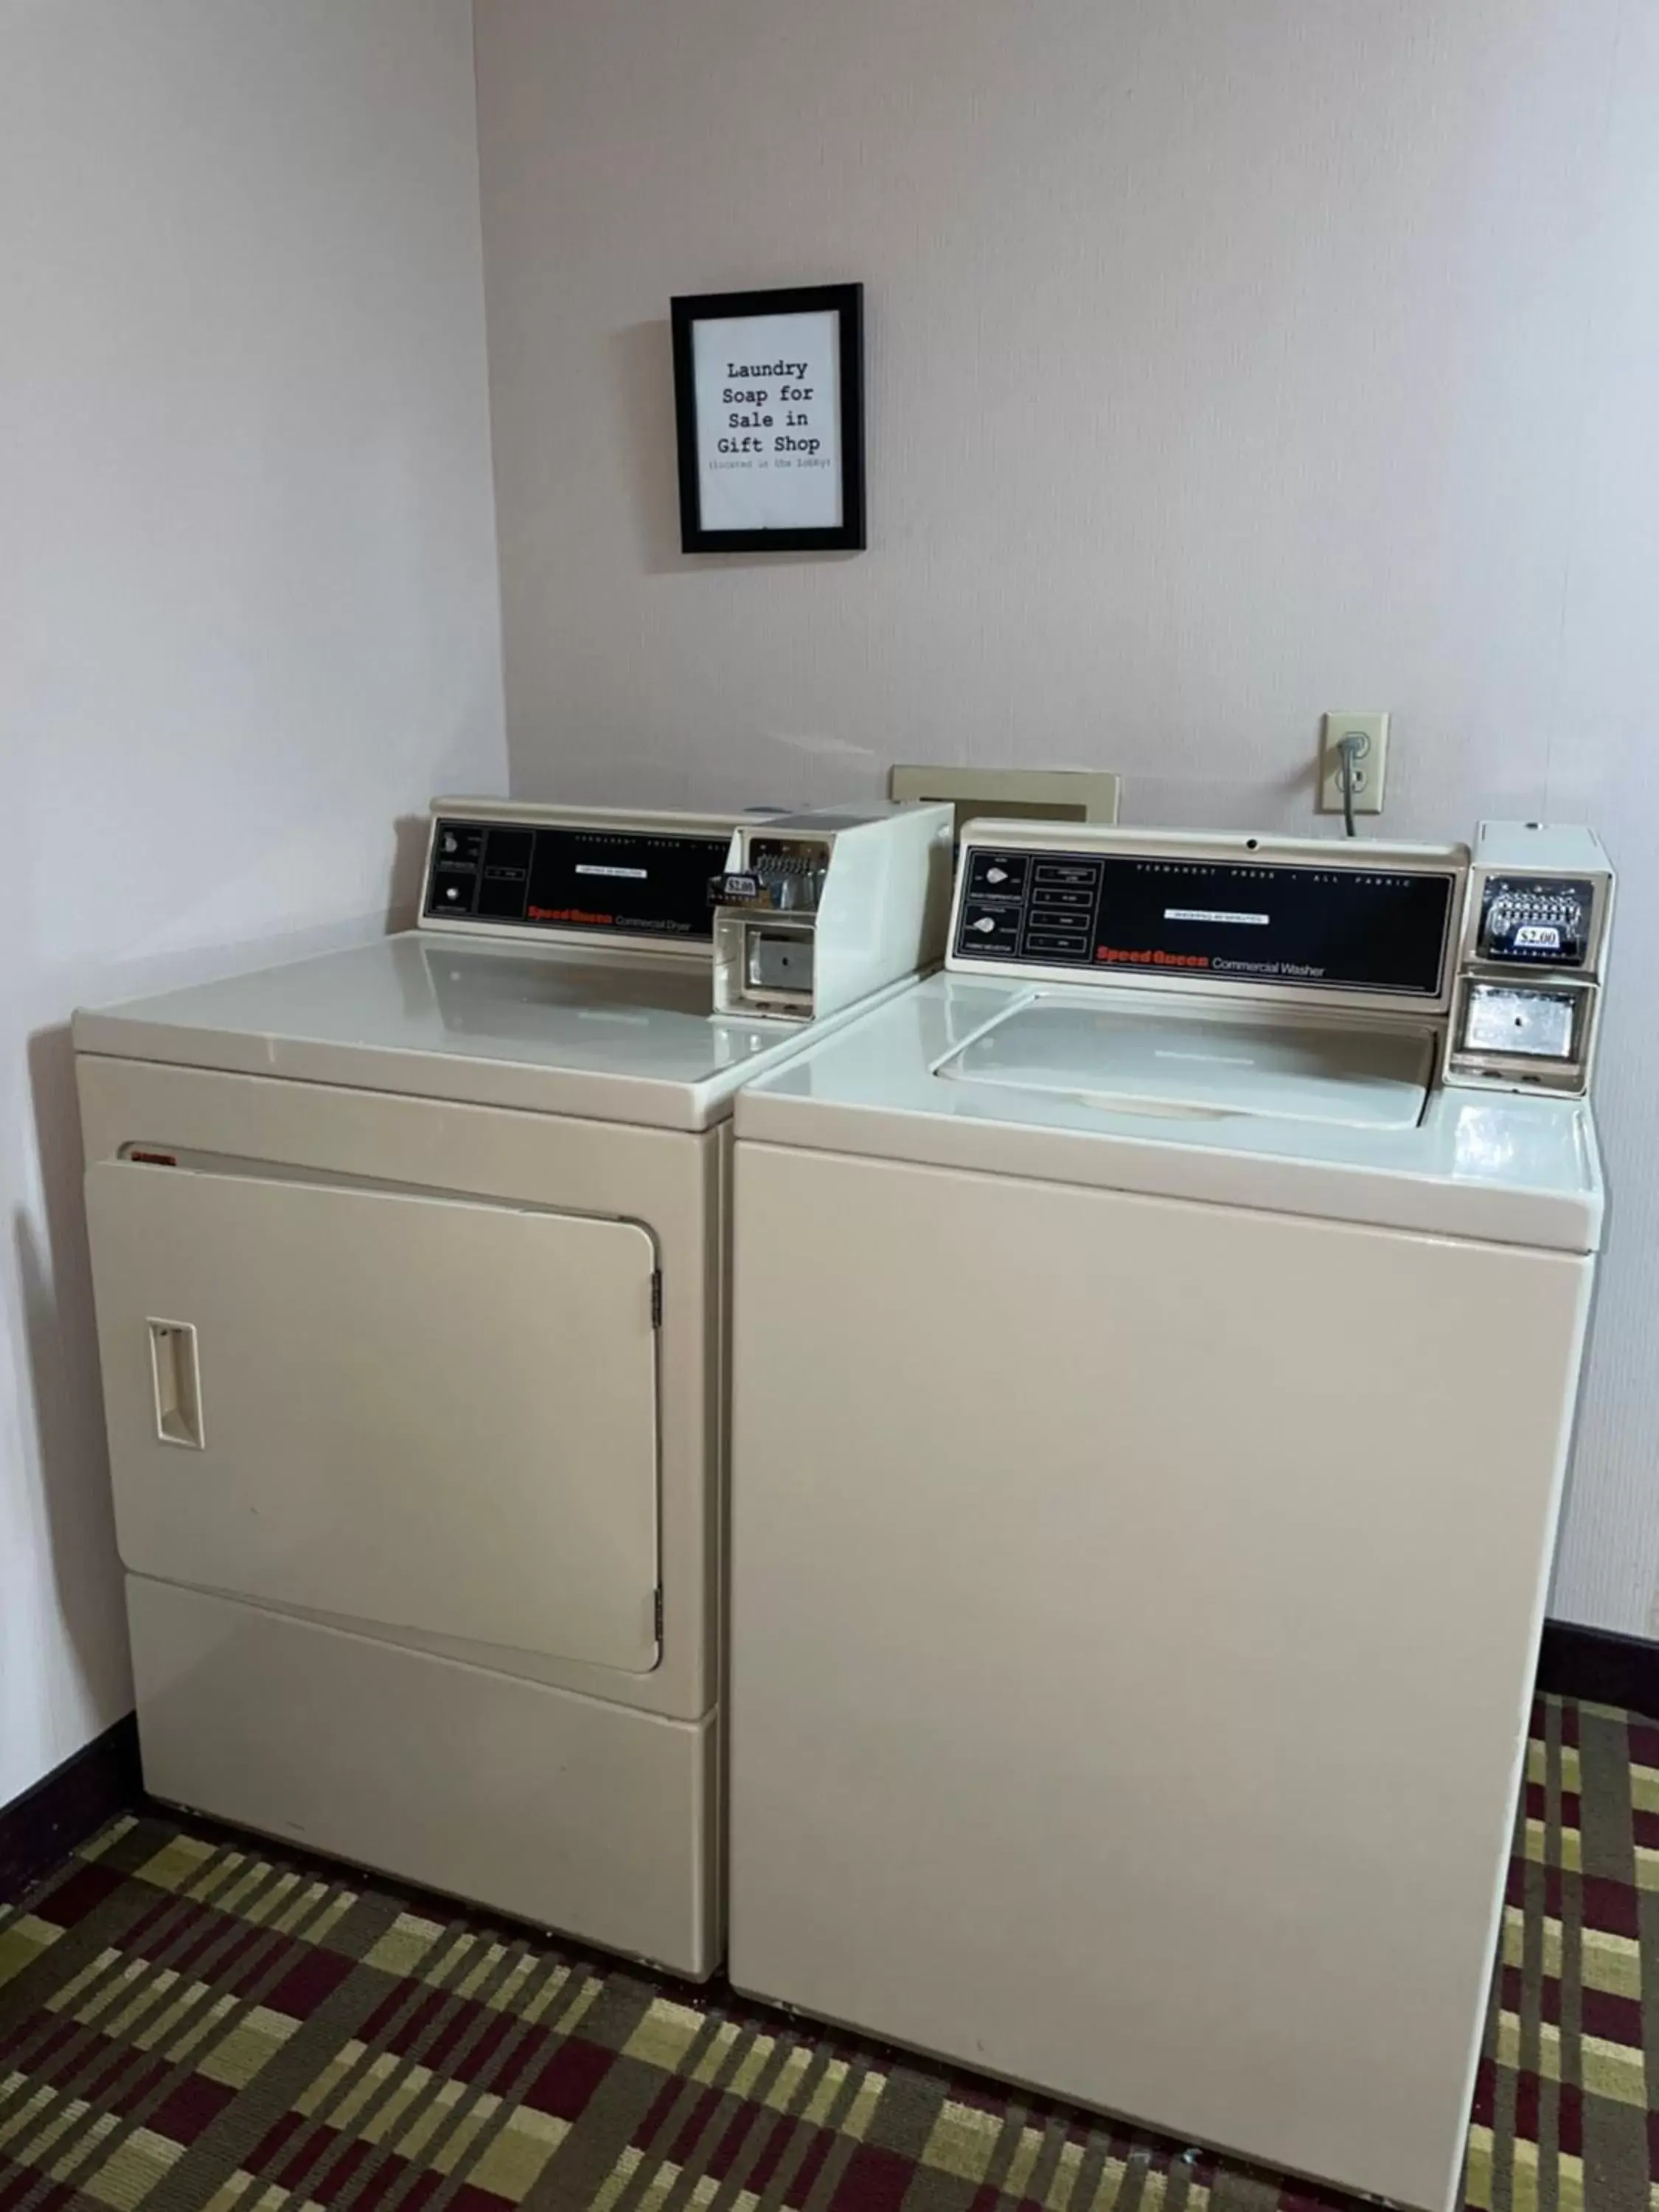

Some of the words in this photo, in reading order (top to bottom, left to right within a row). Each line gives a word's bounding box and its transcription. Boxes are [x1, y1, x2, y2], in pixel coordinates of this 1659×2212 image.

[726, 359, 809, 379] Laundry
[723, 389, 768, 407] Soap
[779, 385, 814, 402] for
[728, 411, 774, 428] Sale
[786, 410, 809, 427] in
[717, 437, 763, 454] Gift
[774, 436, 821, 456] Shop
[1136, 863, 1216, 876] PERMANENT
[1231, 869, 1275, 880] PRESS
[1313, 874, 1339, 884] ALL
[527, 905, 570, 921] Speed
[570, 908, 613, 924] Queen
[615, 914, 664, 929] Commercial
[1520, 929, 1557, 945] $2.00
[1096, 945, 1152, 963] Speed
[1153, 950, 1210, 967] Queen
[1211, 957, 1279, 974] Commercial
[1281, 961, 1326, 978] Washer
